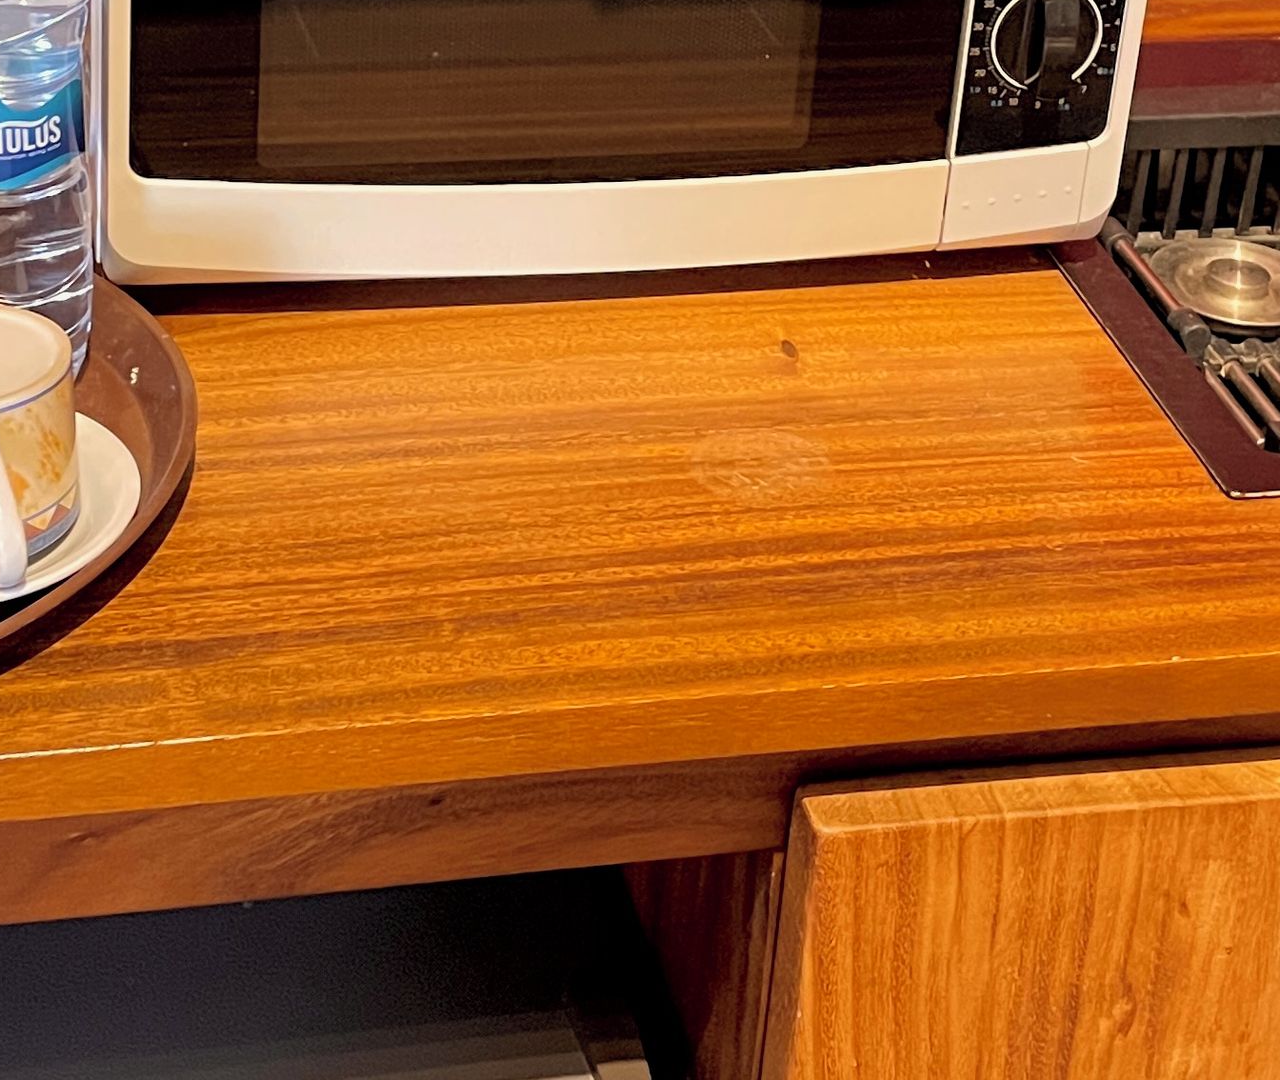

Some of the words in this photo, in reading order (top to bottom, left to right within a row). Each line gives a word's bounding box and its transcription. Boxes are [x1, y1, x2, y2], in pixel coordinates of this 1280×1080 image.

[1114, 18, 1121, 26] 4
[1110, 43, 1117, 52] 5
[1081, 85, 1088, 94] 7
[1034, 100, 1042, 110] 9
